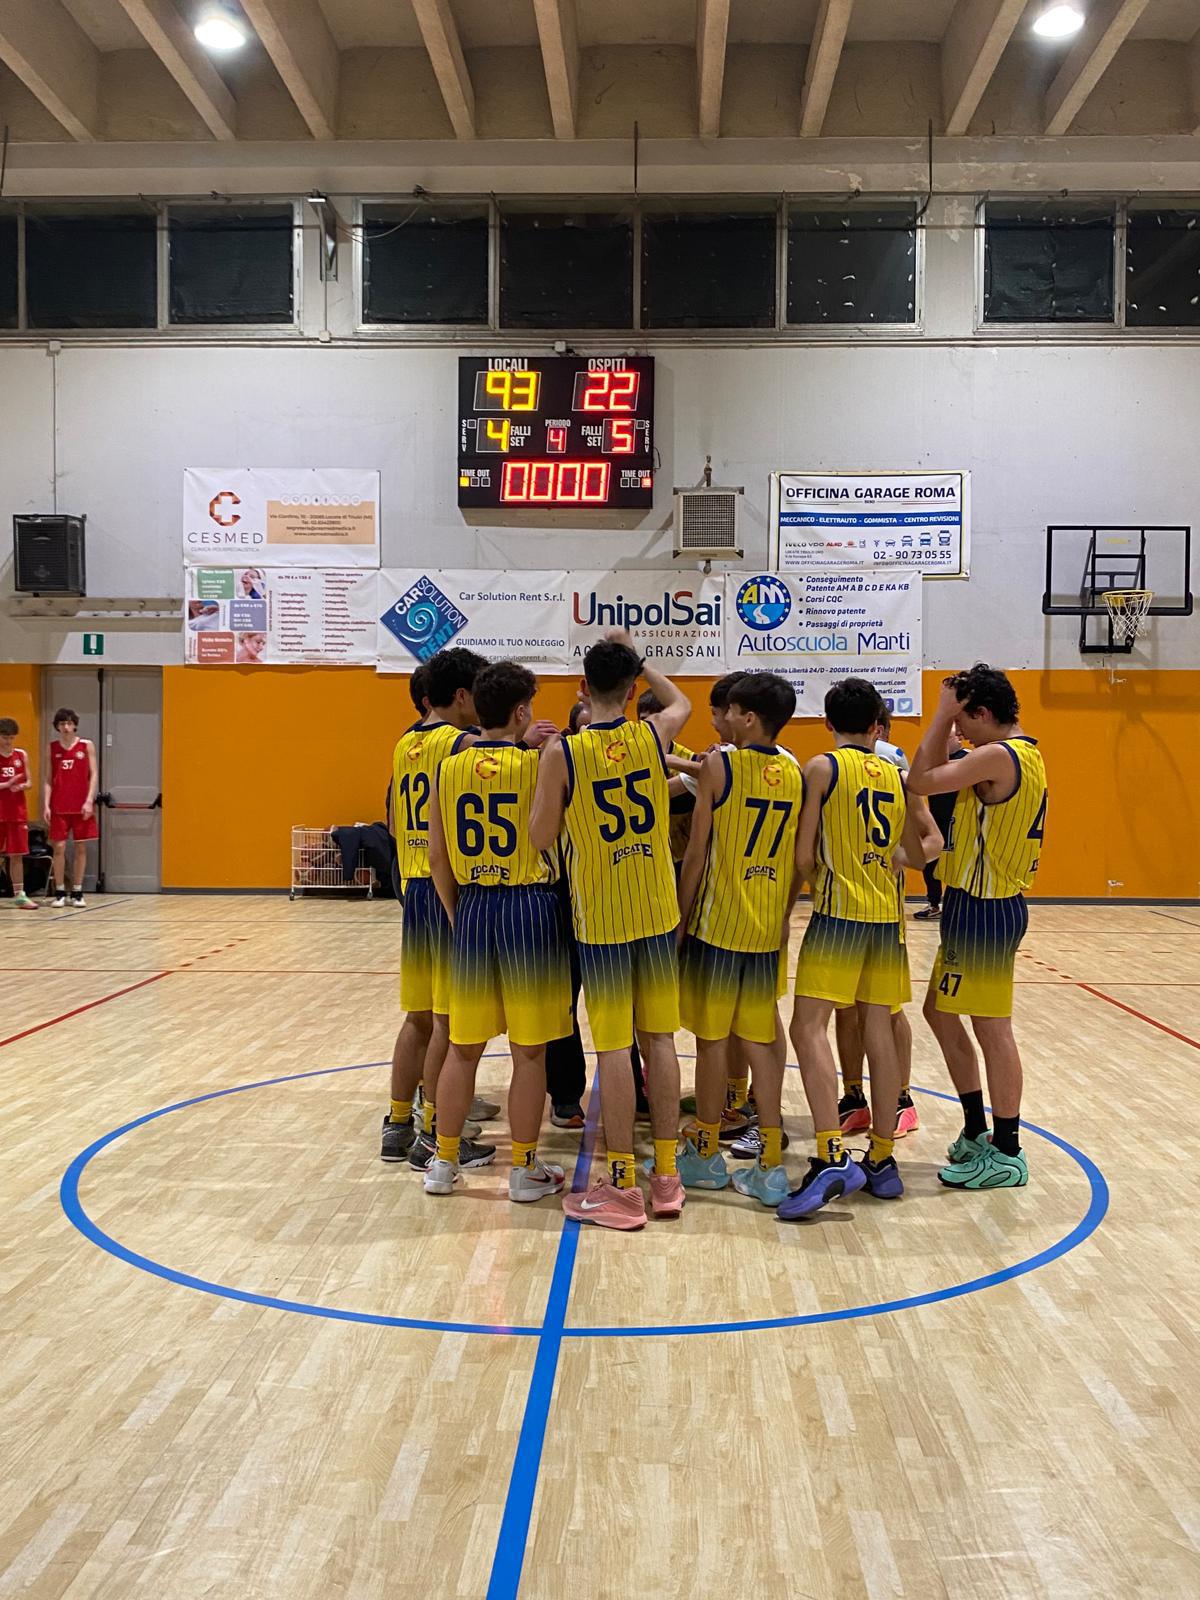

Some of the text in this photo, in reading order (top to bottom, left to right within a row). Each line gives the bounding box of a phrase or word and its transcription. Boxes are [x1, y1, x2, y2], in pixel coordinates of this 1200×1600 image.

[488, 358, 528, 371] LOCALI
[588, 358, 626, 371] OSPITI
[486, 372, 537, 411] 93
[583, 372, 636, 411] 22
[486, 420, 508, 452] 4
[510, 426, 531, 436] FALLI
[550, 430, 563, 450] 4
[581, 426, 602, 436] FALLI
[612, 420, 632, 452] 5
[510, 437, 524, 446] SET
[587, 437, 602, 446] SET
[786, 487, 956, 498] OFFICINA GARAGE ROMA
[188, 532, 263, 544] CESMED
[874, 551, 886, 559] 02
[896, 551, 908, 559] 90
[911, 551, 922, 559] 73
[925, 551, 937, 559] 05
[806, 576, 863, 584] Conseguimento
[394, 587, 424, 614] CAR
[417, 578, 467, 629] SOLUTION
[459, 592, 566, 602] Car Solution Rent S.r.l.
[742, 584, 786, 604] AM
[573, 591, 721, 631] UnipolSai
[806, 620, 839, 629] Passaggi
[849, 620, 883, 628] proprietà
[416, 621, 455, 660] RENT
[737, 632, 910, 656] Autoscuola Marti
[646, 646, 721, 657] GRASSANI
[2, 767, 15, 777] 39
[62, 760, 74, 770] 37
[400, 772, 430, 831] 12
[592, 768, 655, 843] 55
[456, 793, 518, 857] 65
[856, 787, 895, 848] 15
[744, 798, 793, 858] 77
[613, 843, 653, 865] LOCATE
[471, 865, 510, 881] LOCATE
[744, 866, 776, 881] LOCATE
[939, 972, 962, 997] 47
